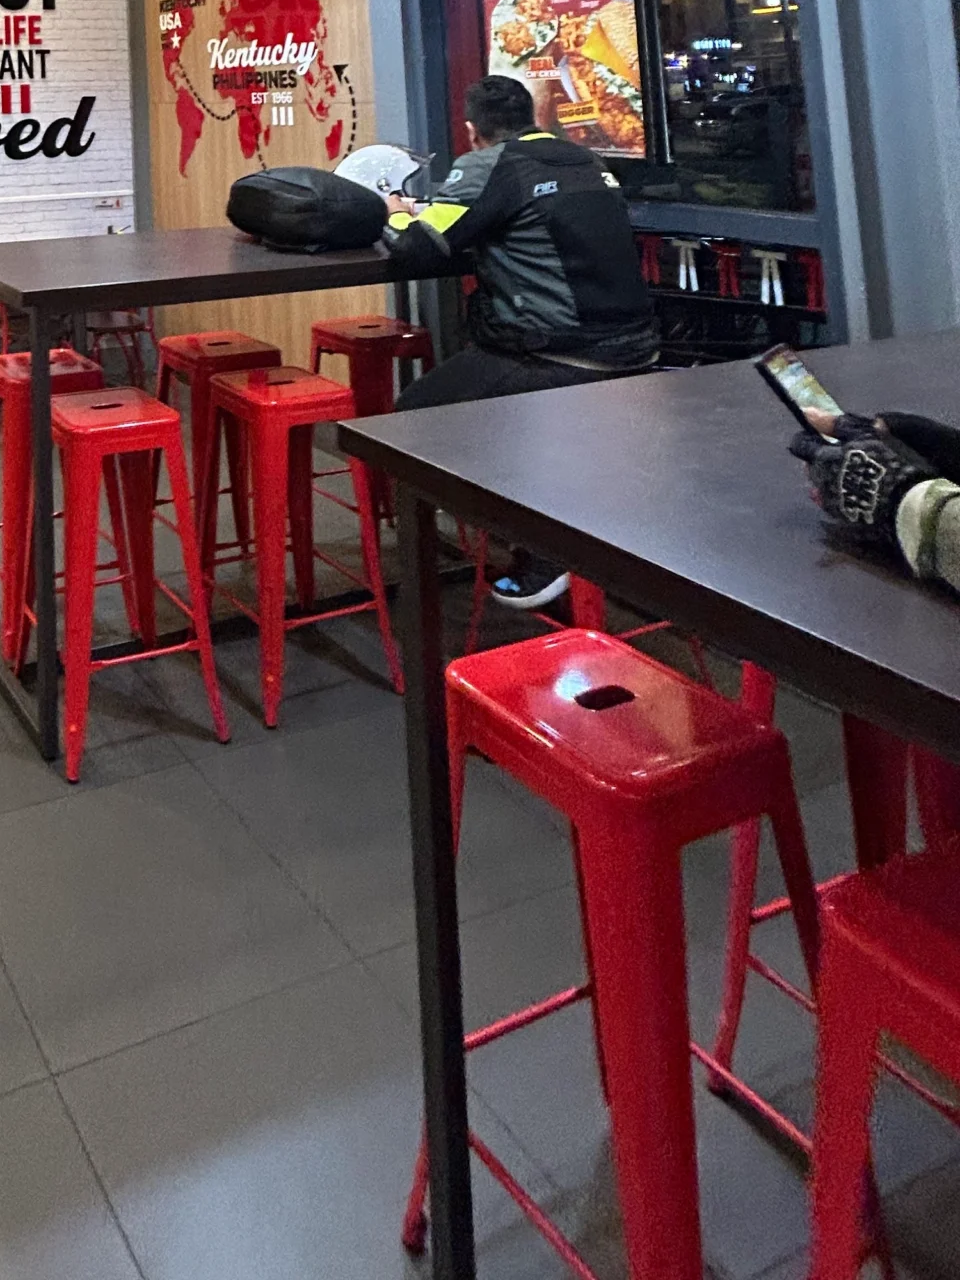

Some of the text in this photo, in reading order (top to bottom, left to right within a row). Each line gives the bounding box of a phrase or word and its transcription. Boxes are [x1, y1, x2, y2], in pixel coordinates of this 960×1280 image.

[159, 12, 182, 31] USA
[206, 32, 319, 75] Kentucky
[212, 69, 297, 90] PHILIPPINES
[251, 92, 269, 104] EST
